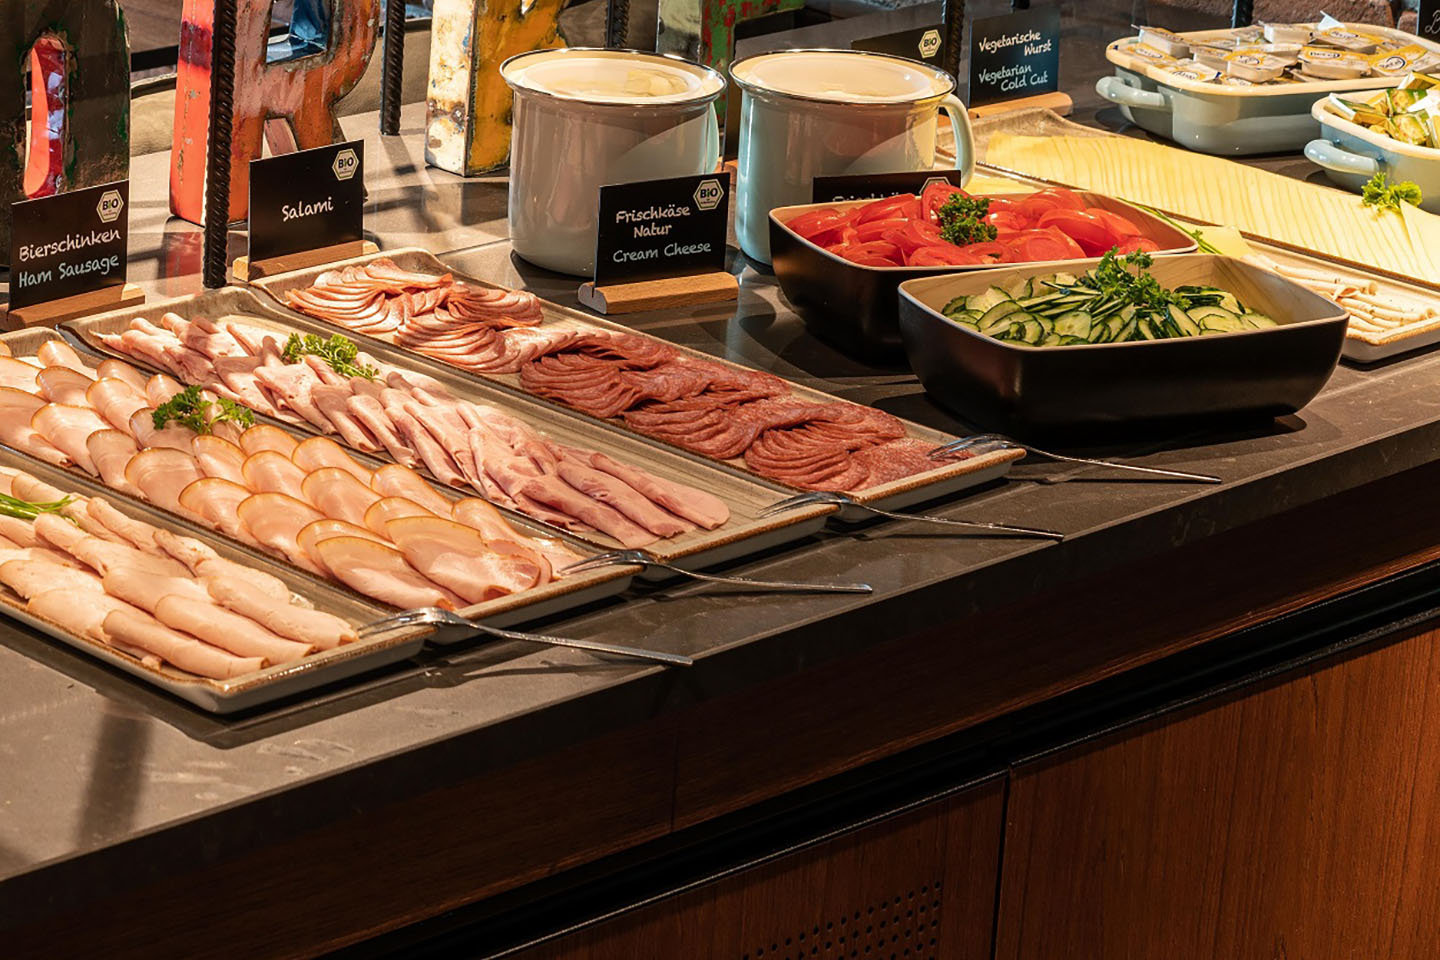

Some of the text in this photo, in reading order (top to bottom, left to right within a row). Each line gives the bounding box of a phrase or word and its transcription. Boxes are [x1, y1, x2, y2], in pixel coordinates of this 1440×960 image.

[979, 29, 1041, 54] Vegetarische
[1024, 39, 1052, 56] Wurst
[978, 64, 1032, 84] Vegetarian
[1000, 71, 1048, 91] Cold Cut
[281, 196, 334, 222] Salami
[615, 204, 691, 223] Frischkäse
[633, 222, 672, 238] Natur
[19, 229, 121, 261] Bierschinken
[613, 242, 712, 263] Cream Cheese
[18, 254, 119, 288] Ham Sausage
